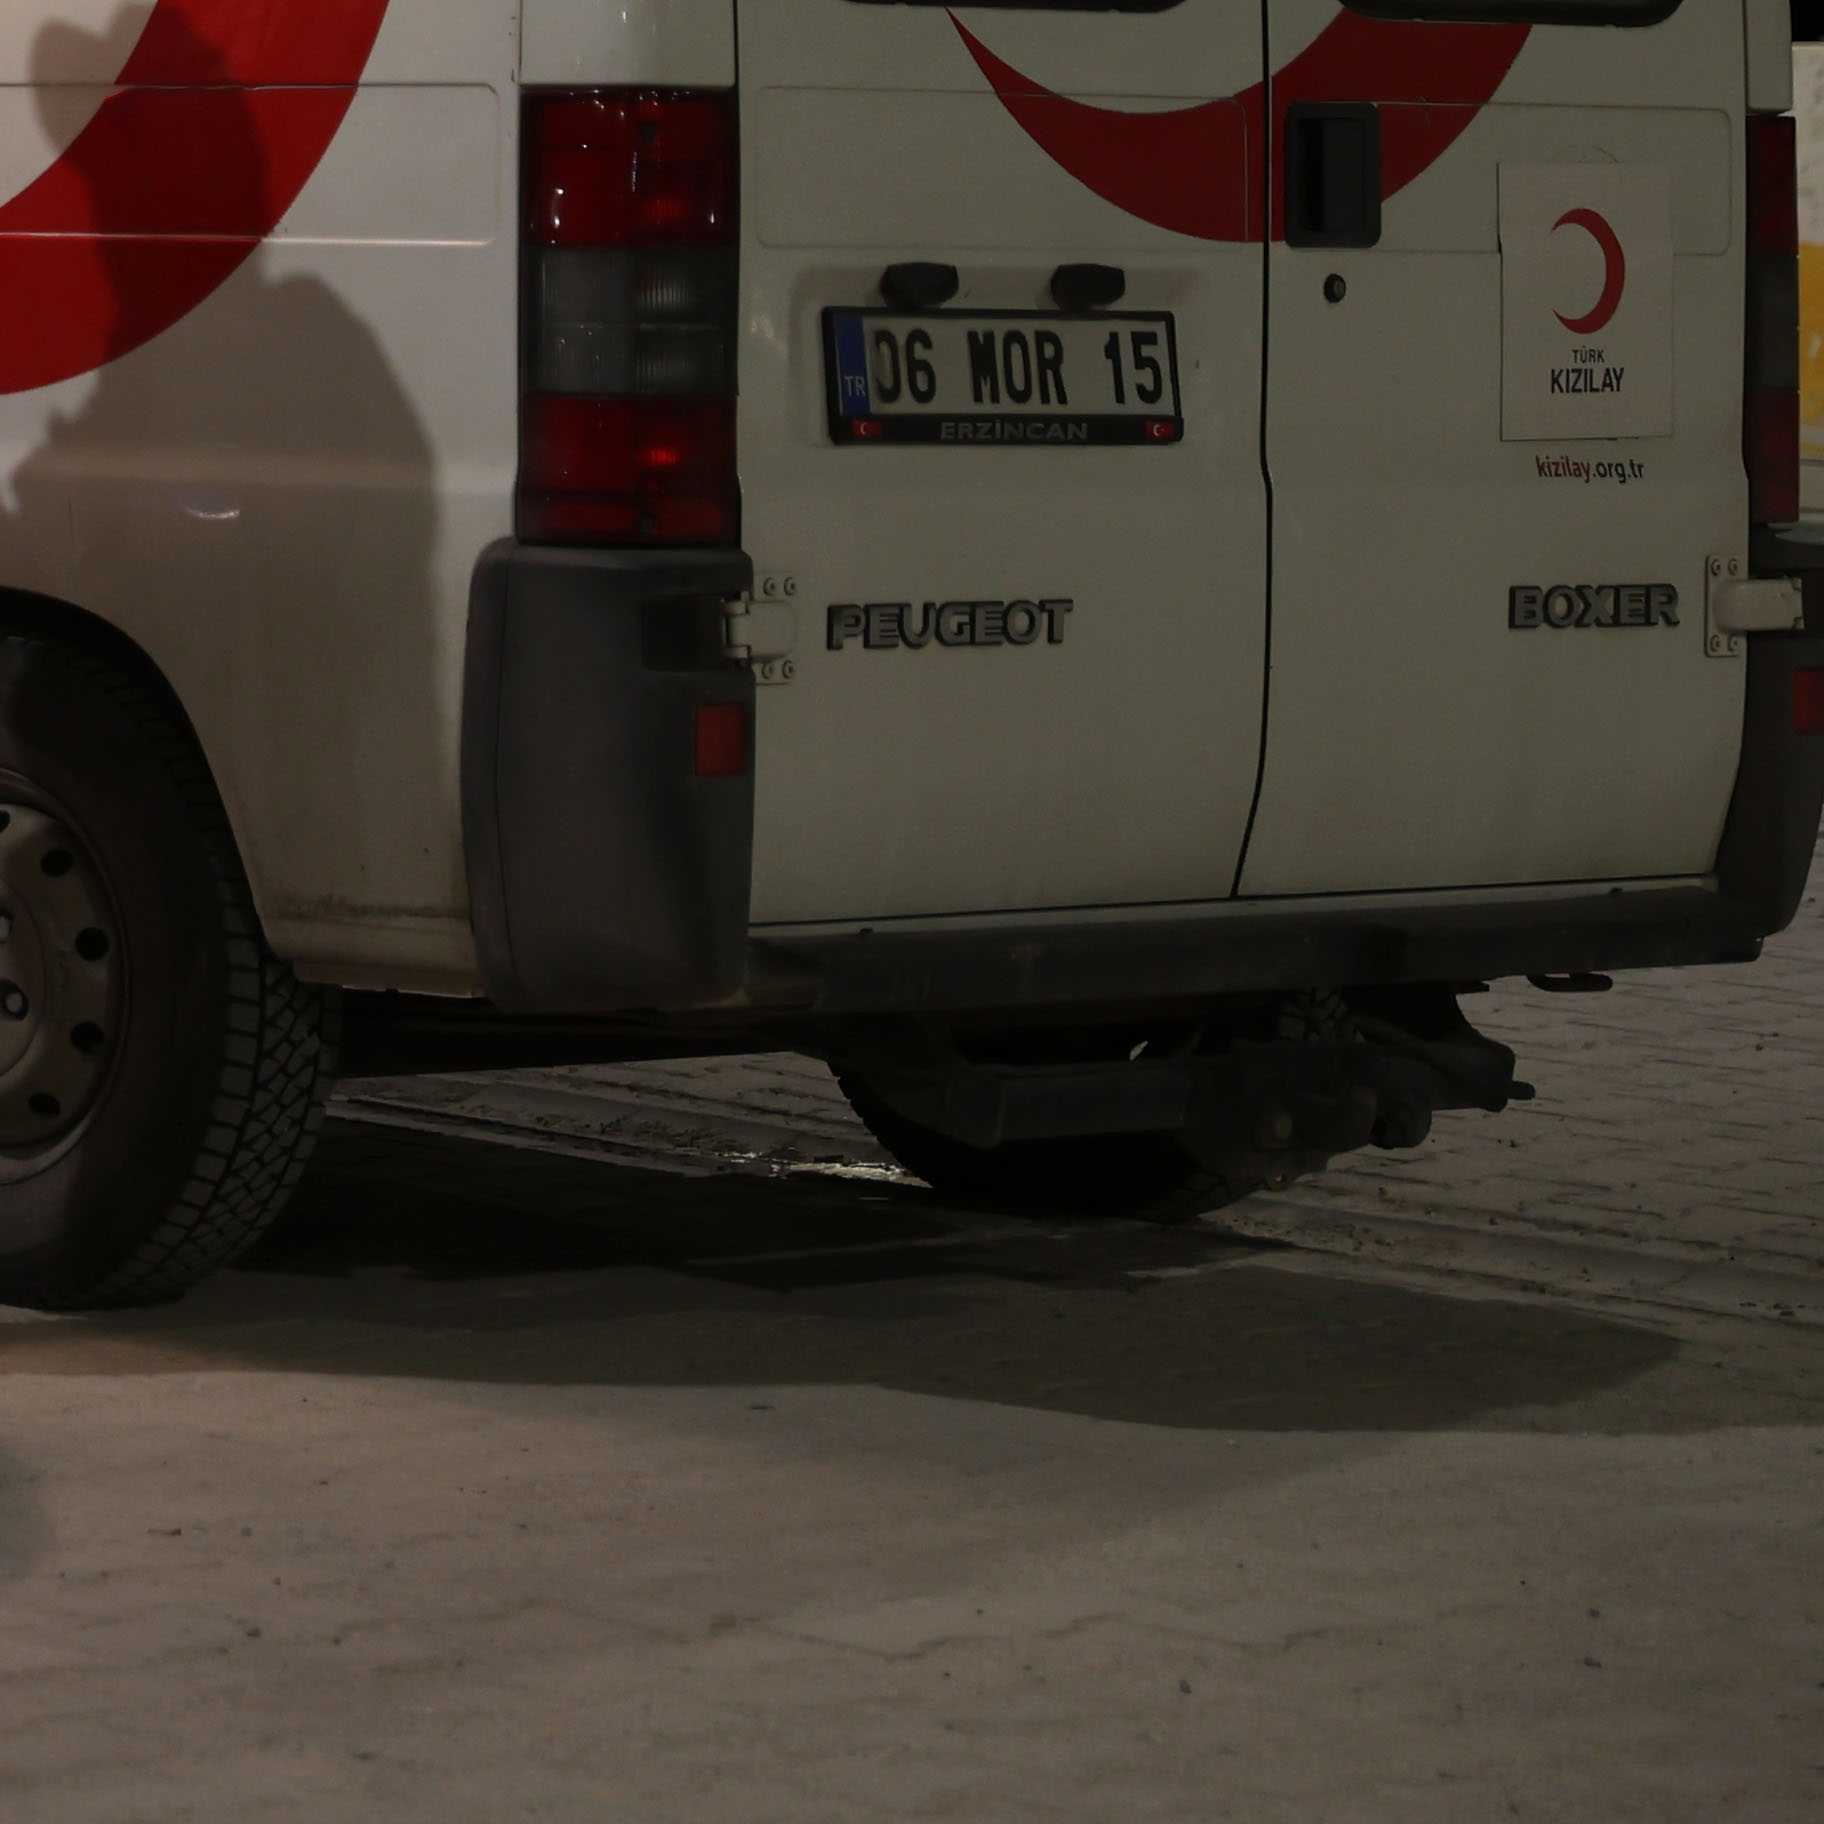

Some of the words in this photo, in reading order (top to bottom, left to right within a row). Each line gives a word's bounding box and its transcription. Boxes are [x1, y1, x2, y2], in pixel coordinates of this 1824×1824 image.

[966, 329, 1069, 406] MOR
[1103, 330, 1163, 405] 15
[1571, 345, 1605, 364] TÜRK
[843, 375, 868, 398] TR
[1551, 367, 1625, 394] KIZILAY
[939, 420, 1089, 441] ERZİNCAN
[1535, 454, 1645, 485] kizilay.org.tr
[1507, 583, 1681, 630] BOXER
[825, 598, 1075, 652] PEUGEOT
